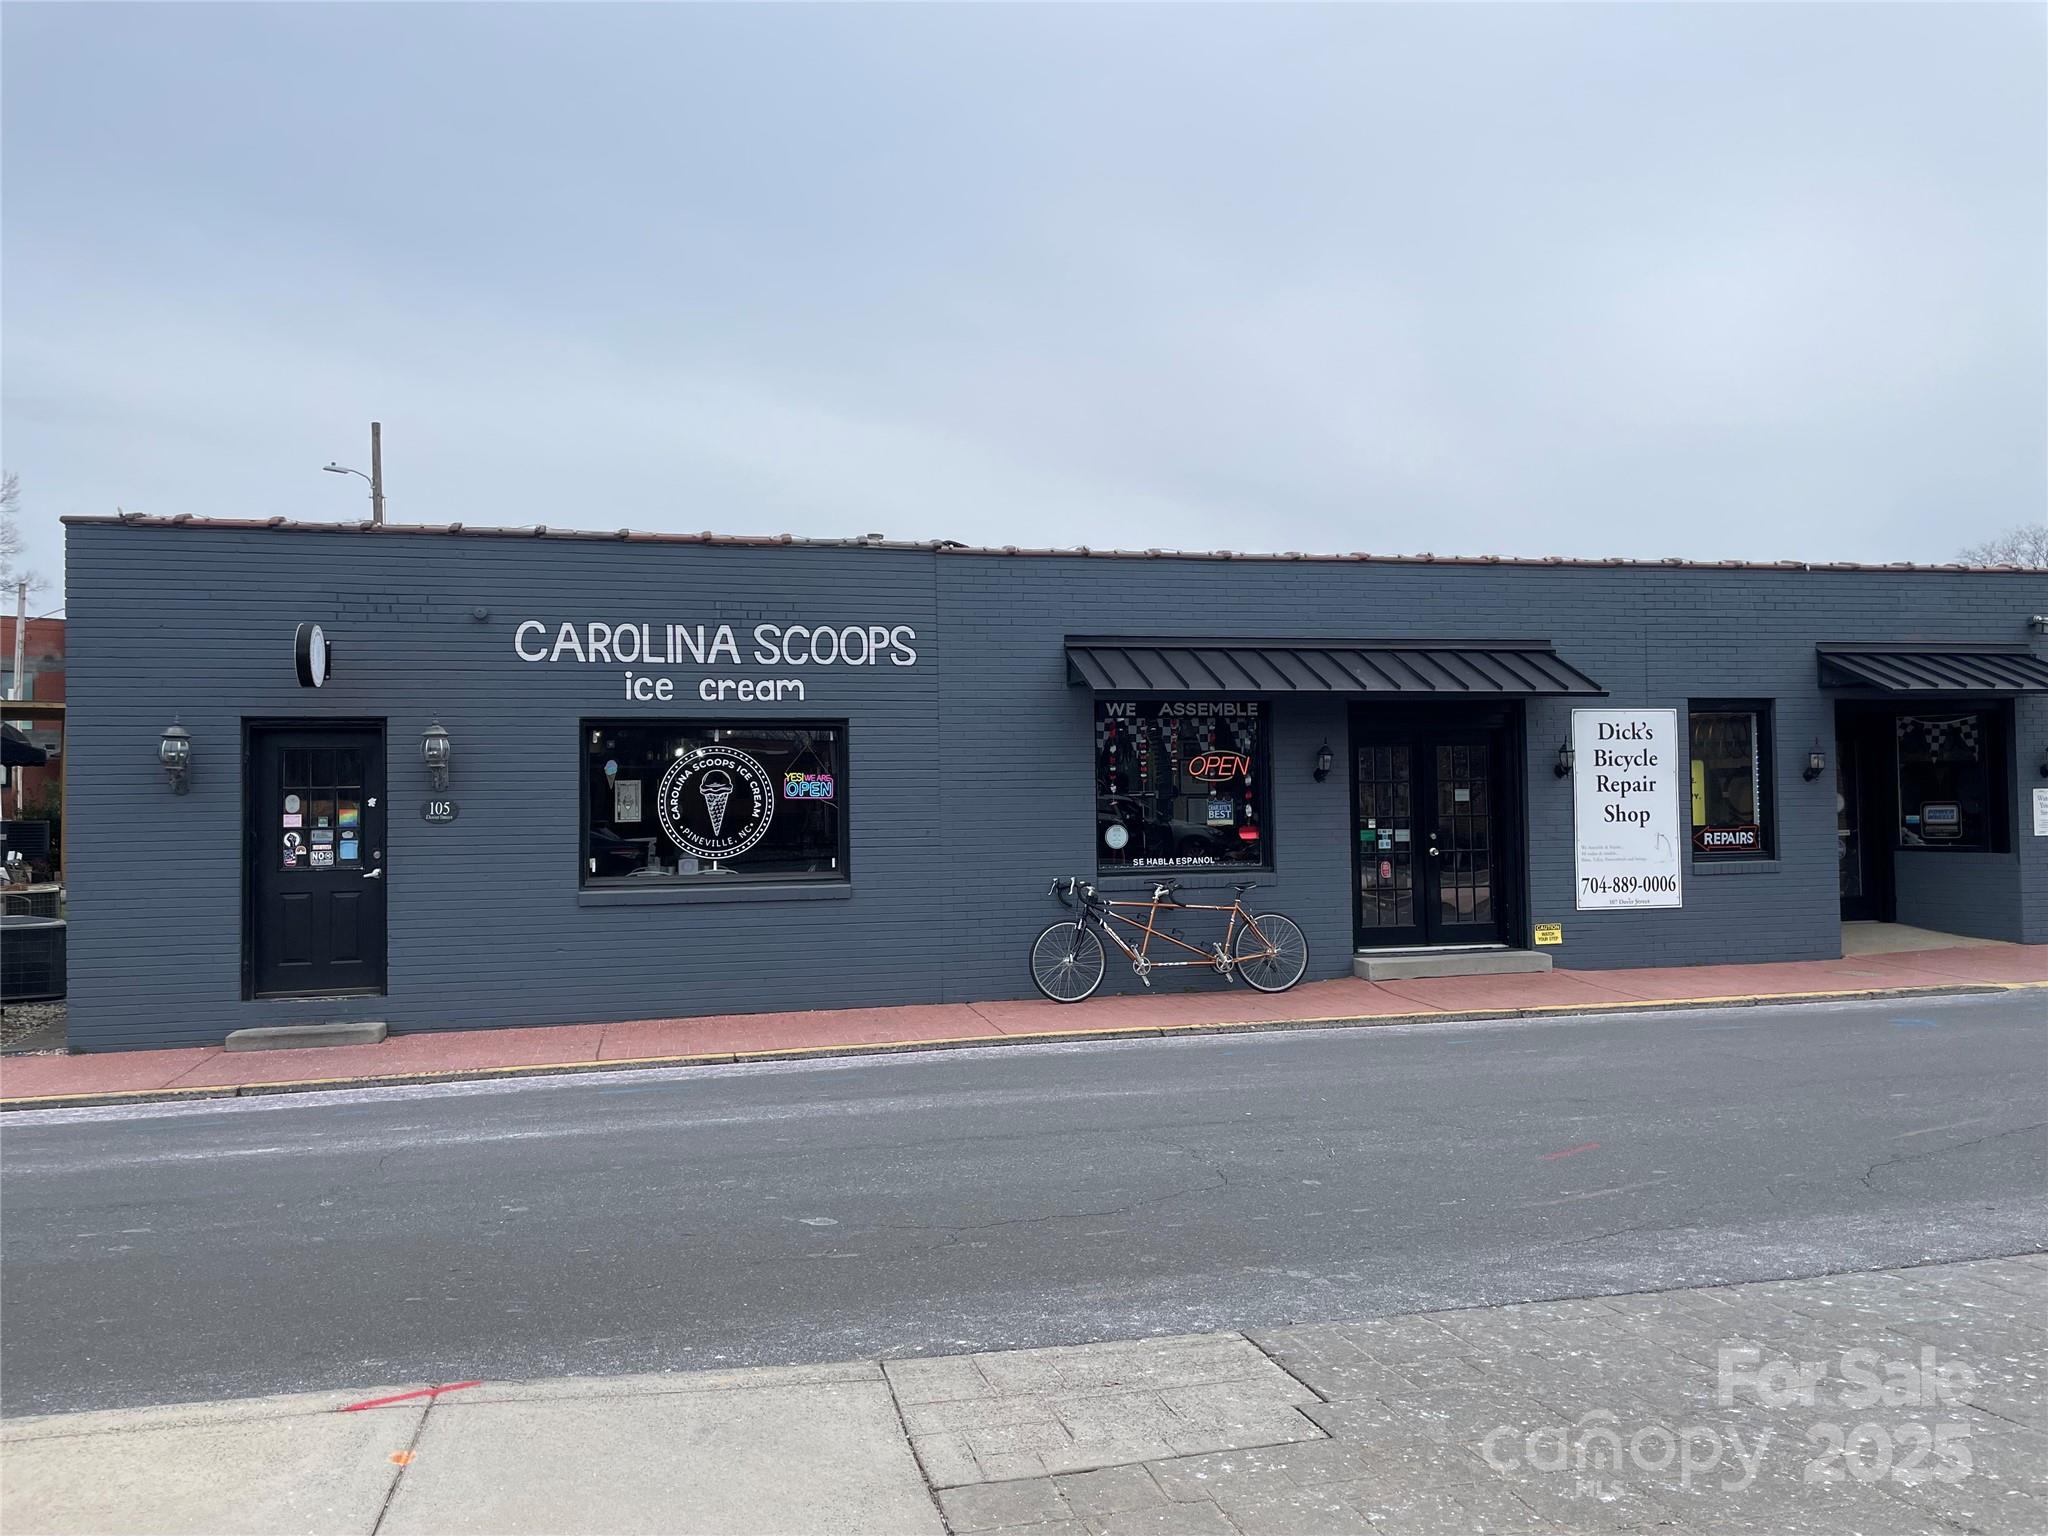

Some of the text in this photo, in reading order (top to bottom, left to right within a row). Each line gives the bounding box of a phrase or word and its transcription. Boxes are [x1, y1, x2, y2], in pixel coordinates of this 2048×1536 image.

[514, 620, 918, 667] CAROLINA SCOOPS
[624, 671, 805, 702] ice cream
[1105, 703, 1258, 716] WE ASSEMBLE
[1598, 722, 1653, 740] Dick's
[1188, 755, 1249, 776] OPEN
[1593, 748, 1658, 772] Bicycle
[670, 758, 762, 820] CAROLINA SCOOPS ICE CREAM
[786, 781, 832, 797] OPEN
[1596, 774, 1656, 797] Repair
[430, 801, 450, 815] 105
[1208, 810, 1232, 819] BEST
[1603, 804, 1650, 827] Shop
[738, 825, 752, 839] NC
[1703, 832, 1754, 845] REPAIRS
[1133, 856, 1215, 866] SE HABLA ESPANOL
[1581, 874, 1677, 895] 704-889-0006
